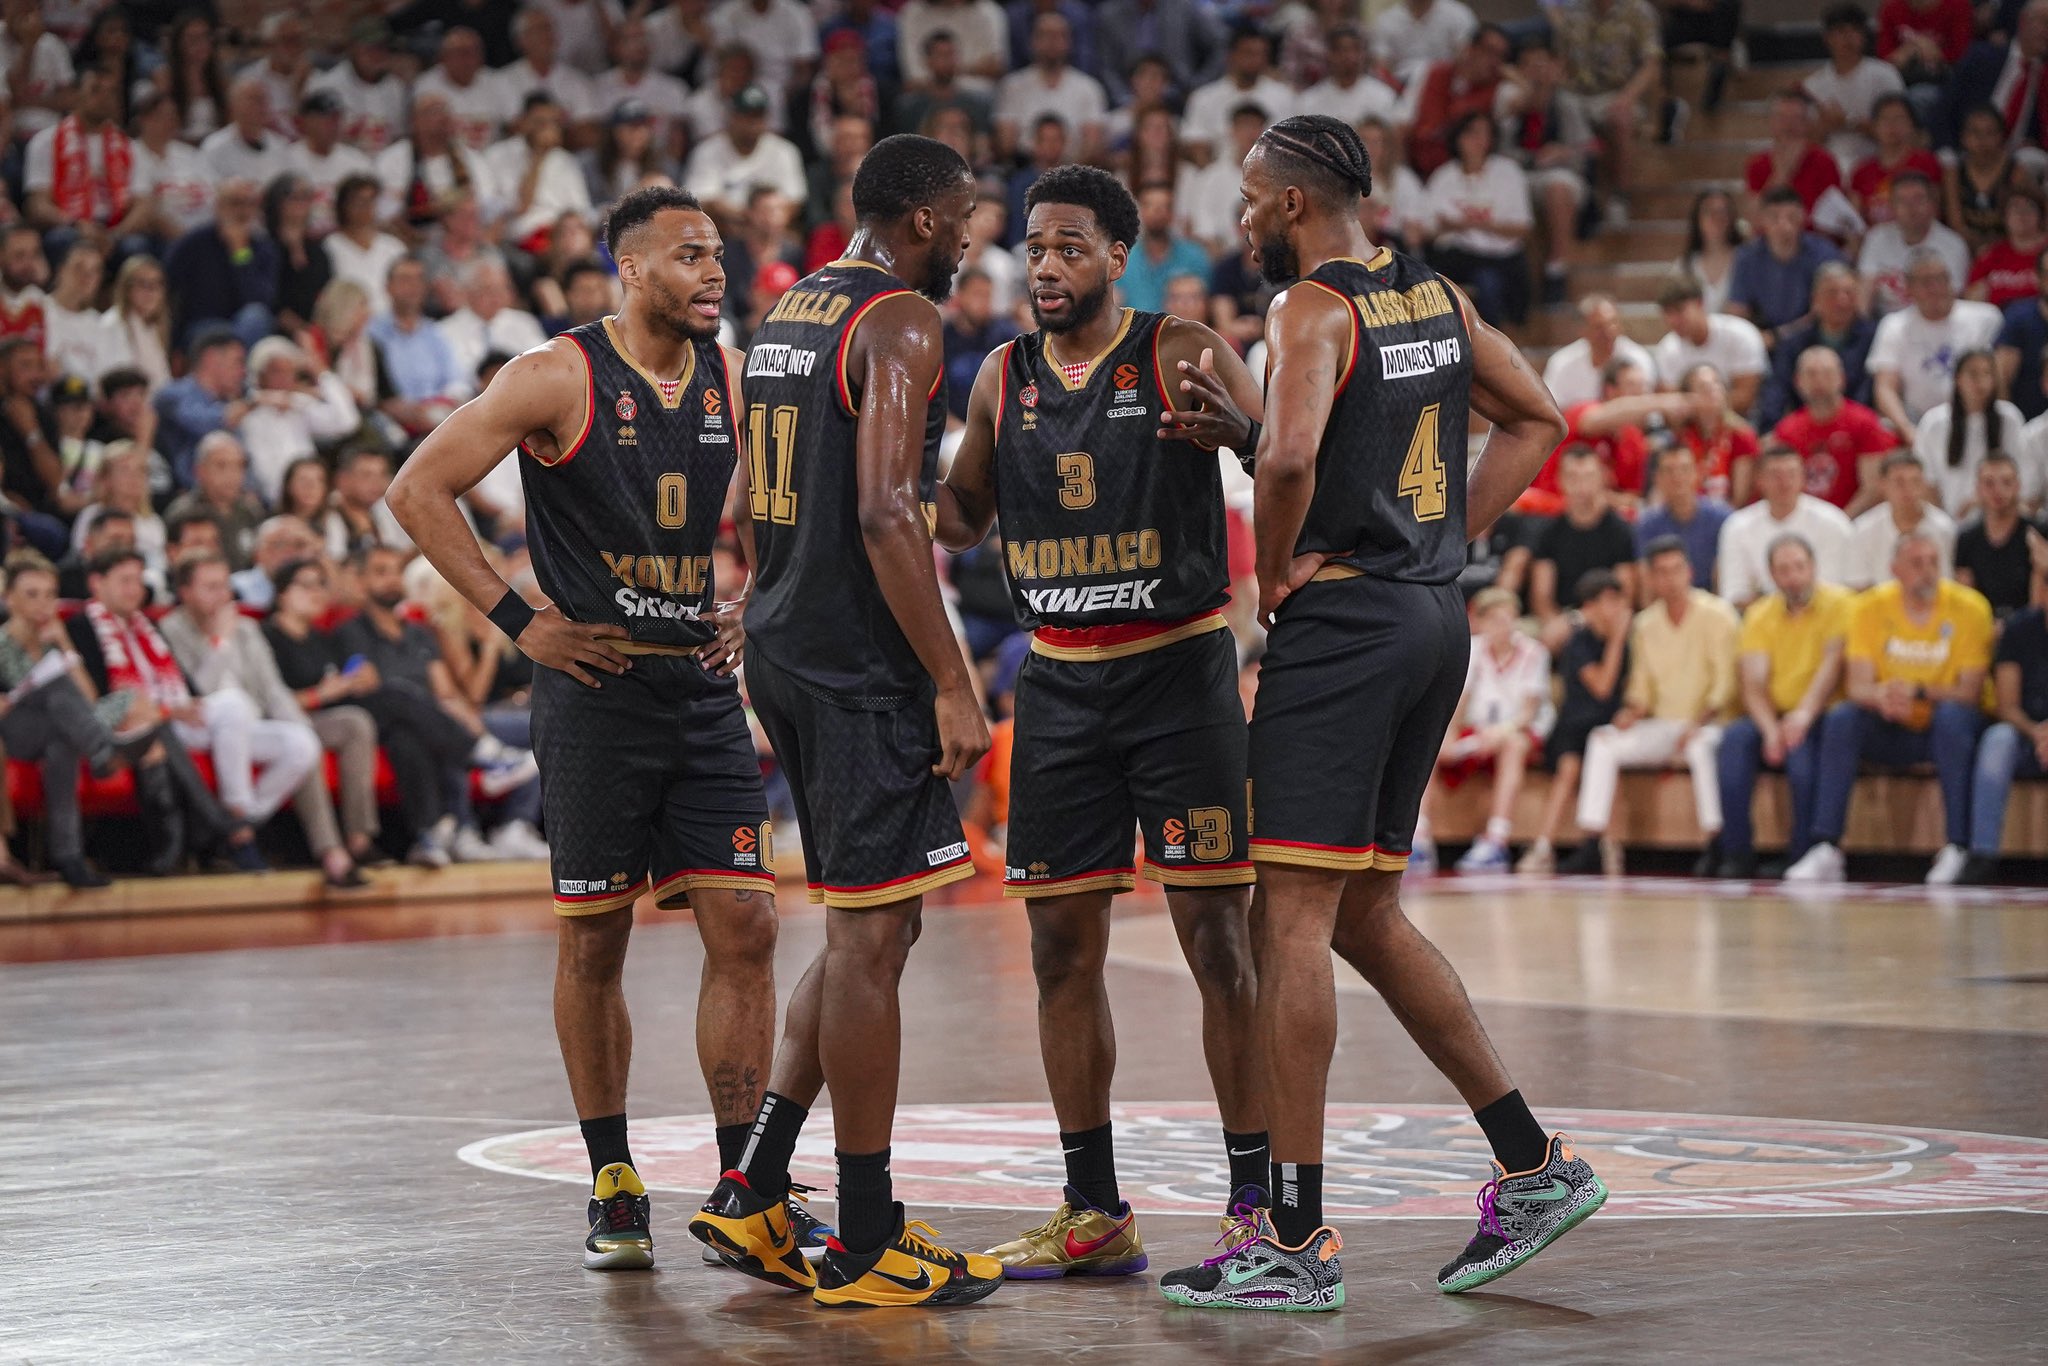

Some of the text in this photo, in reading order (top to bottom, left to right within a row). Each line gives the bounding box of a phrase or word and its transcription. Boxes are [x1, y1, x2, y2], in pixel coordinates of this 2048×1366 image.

[748, 347, 817, 377] MONACO INFO
[1384, 337, 1461, 375] MONACO INFO
[748, 403, 799, 526] 11
[1056, 452, 1097, 510] 3
[1397, 402, 1447, 523] 4
[656, 472, 687, 529] 0
[1007, 528, 1162, 580] MONACO
[1020, 578, 1162, 615] KWEEK
[1188, 806, 1233, 862] 3
[928, 844, 963, 864] MONACO
[587, 880, 607, 892] INFO
[1011, 868, 1026, 880] INFO
[1282, 1181, 1298, 1208] NIKE
